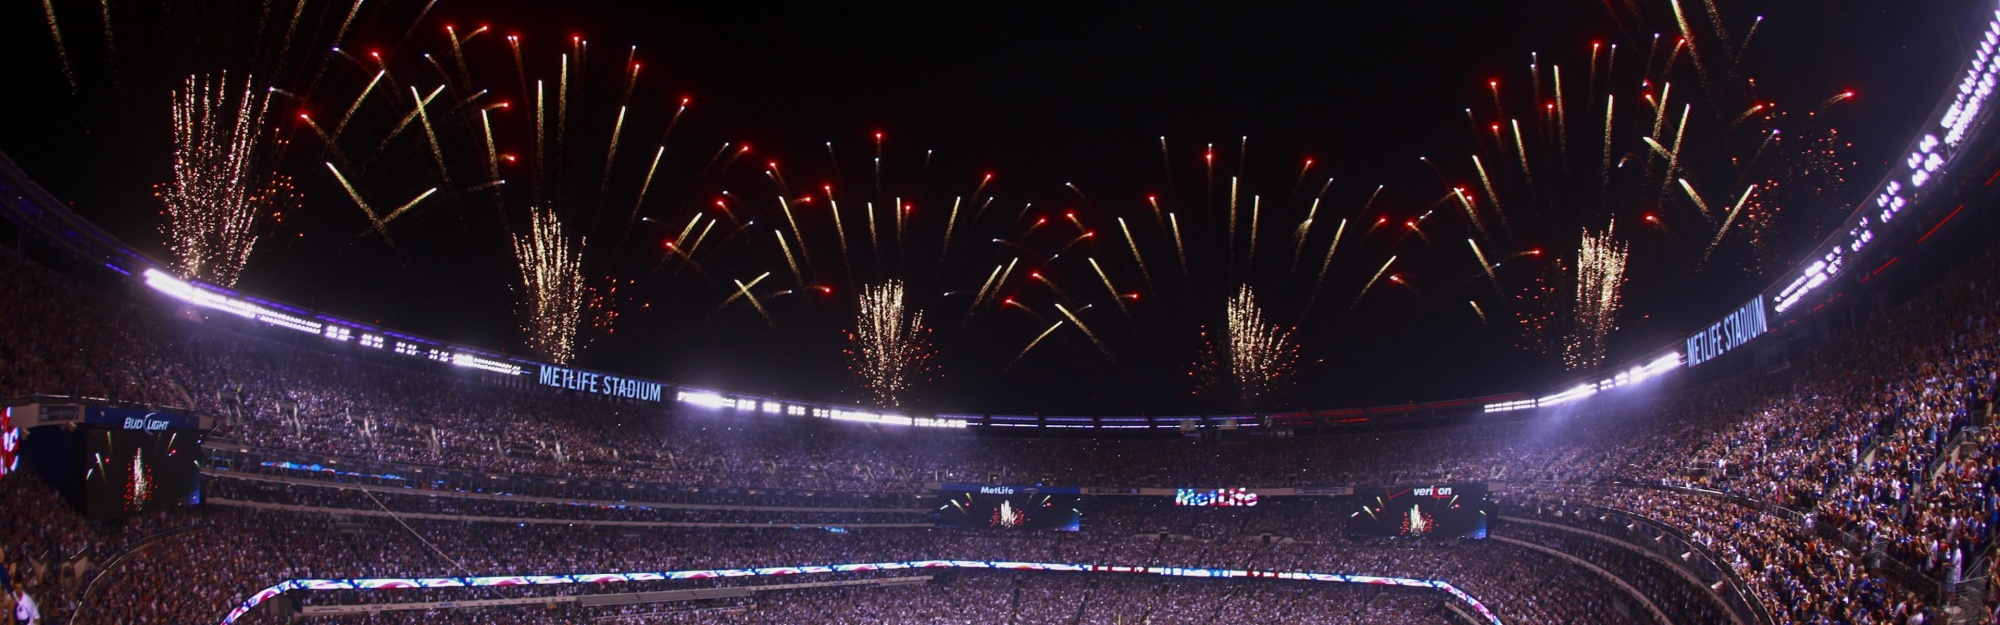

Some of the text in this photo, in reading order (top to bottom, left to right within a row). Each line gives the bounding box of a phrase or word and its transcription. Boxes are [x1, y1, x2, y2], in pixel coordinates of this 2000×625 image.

[1687, 294, 1767, 368] METLIFE STADIUM
[539, 365, 661, 402] METLIFE STADIUM
[123, 417, 169, 430] BUD LIGHT
[980, 486, 1014, 495] MetLife
[1175, 487, 1258, 507] MetLife
[1413, 485, 1452, 498] verizon
